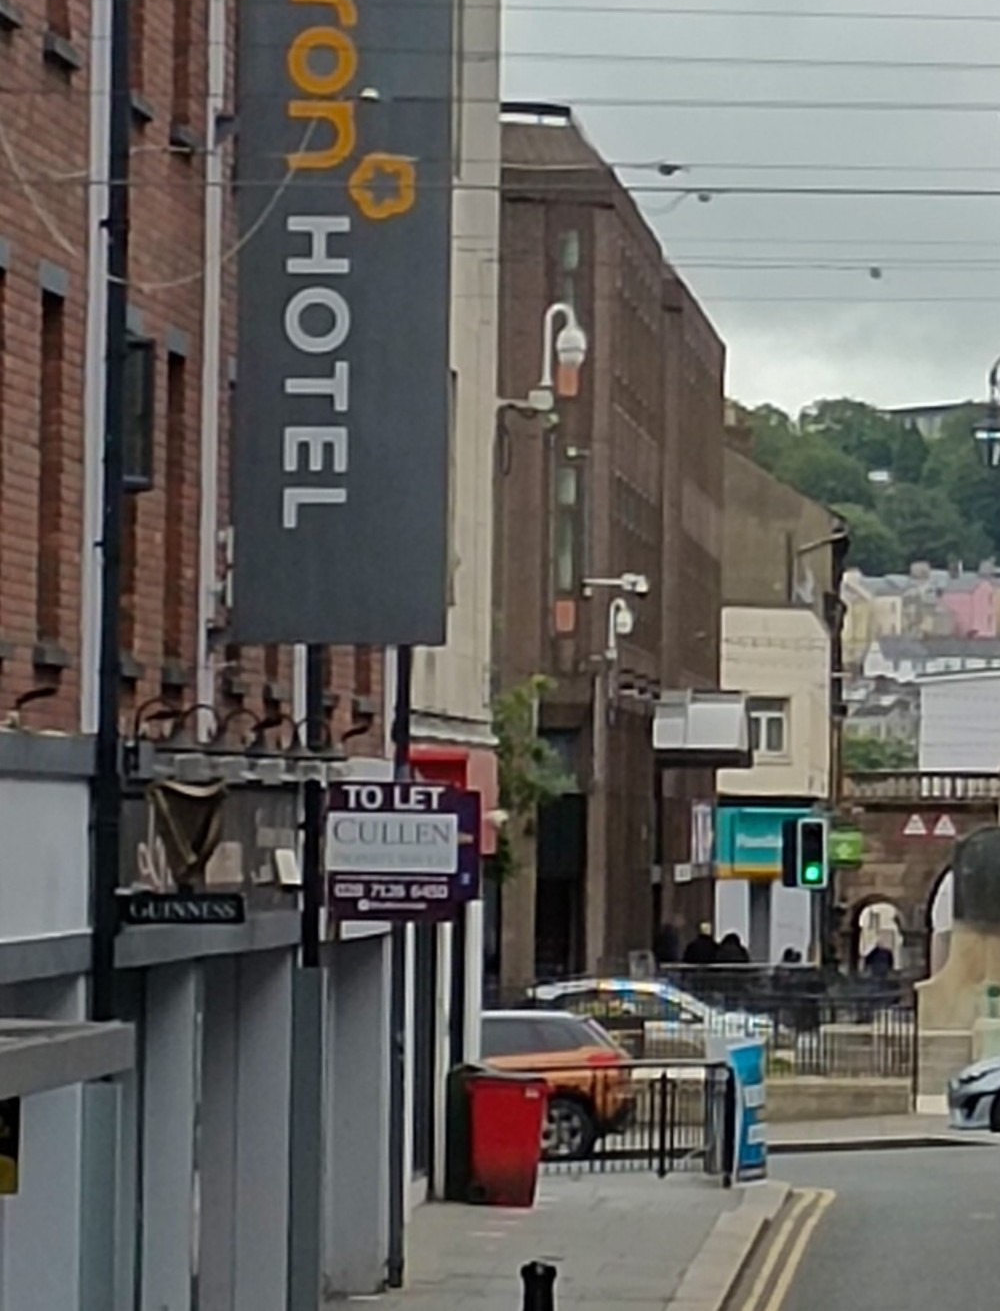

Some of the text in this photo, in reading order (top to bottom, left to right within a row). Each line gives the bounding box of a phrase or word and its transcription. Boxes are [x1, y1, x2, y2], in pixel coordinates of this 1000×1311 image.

[283, 215, 351, 529] HOTEL
[341, 785, 446, 810] TO LET
[129, 899, 236, 919] GUINNESS
